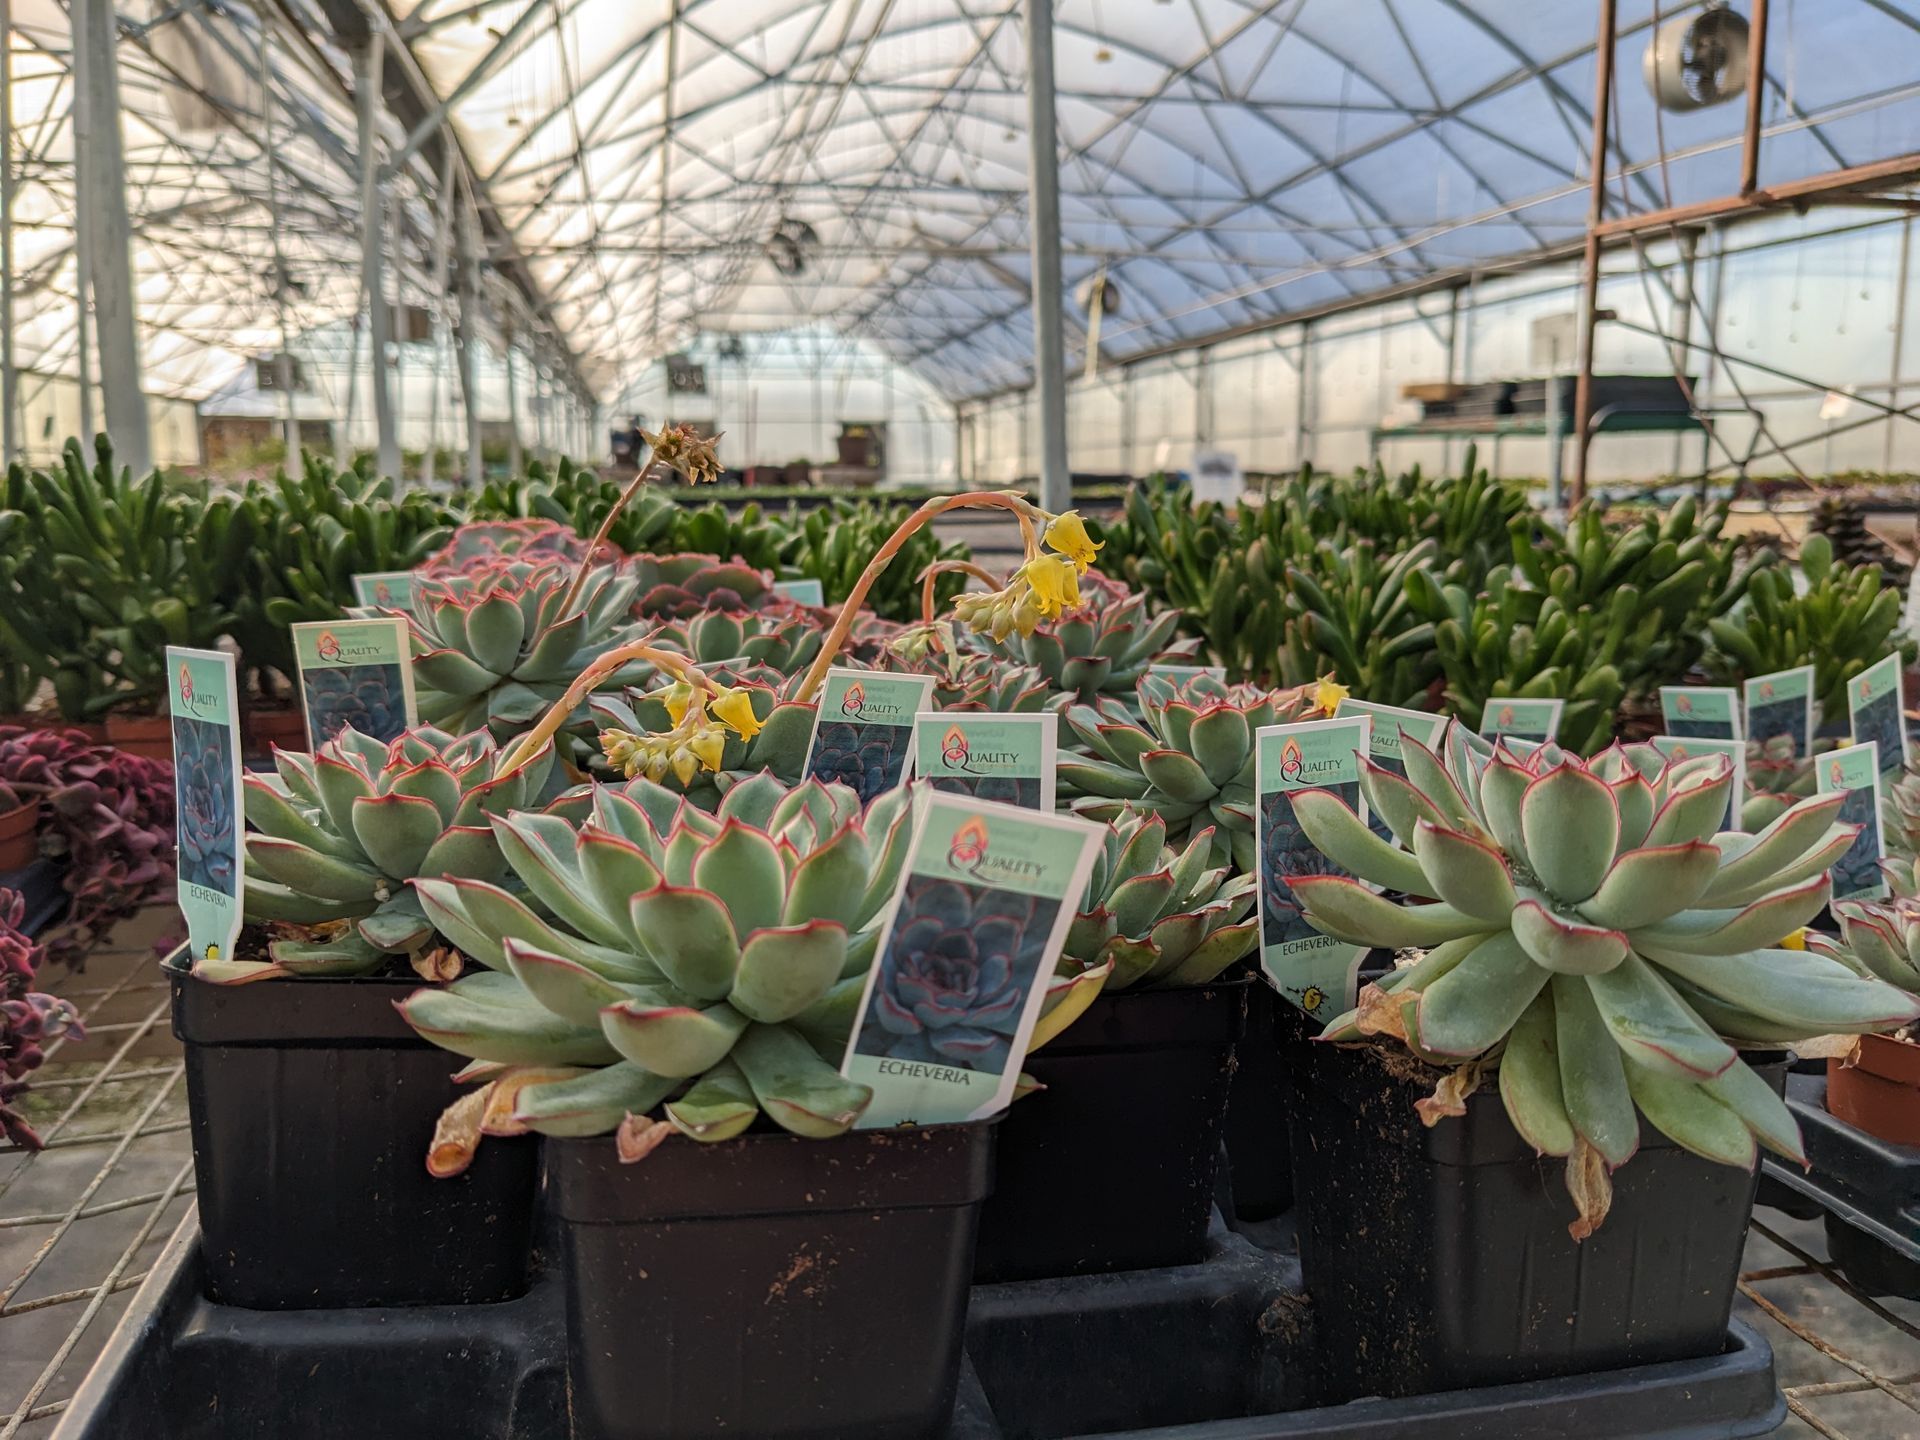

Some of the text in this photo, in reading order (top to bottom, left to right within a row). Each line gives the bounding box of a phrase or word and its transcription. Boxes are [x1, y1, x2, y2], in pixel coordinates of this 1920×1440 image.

[320, 645, 382, 665] QUALITY
[181, 685, 218, 718] QUALITY
[841, 698, 902, 722] QUALITY
[941, 747, 1020, 775] QUALITY
[1280, 759, 1343, 785] QUALITY
[946, 842, 1047, 884] QUALITY
[190, 885, 227, 909] ECHEVERIA
[878, 1059, 971, 1086] ECHEVERIA
